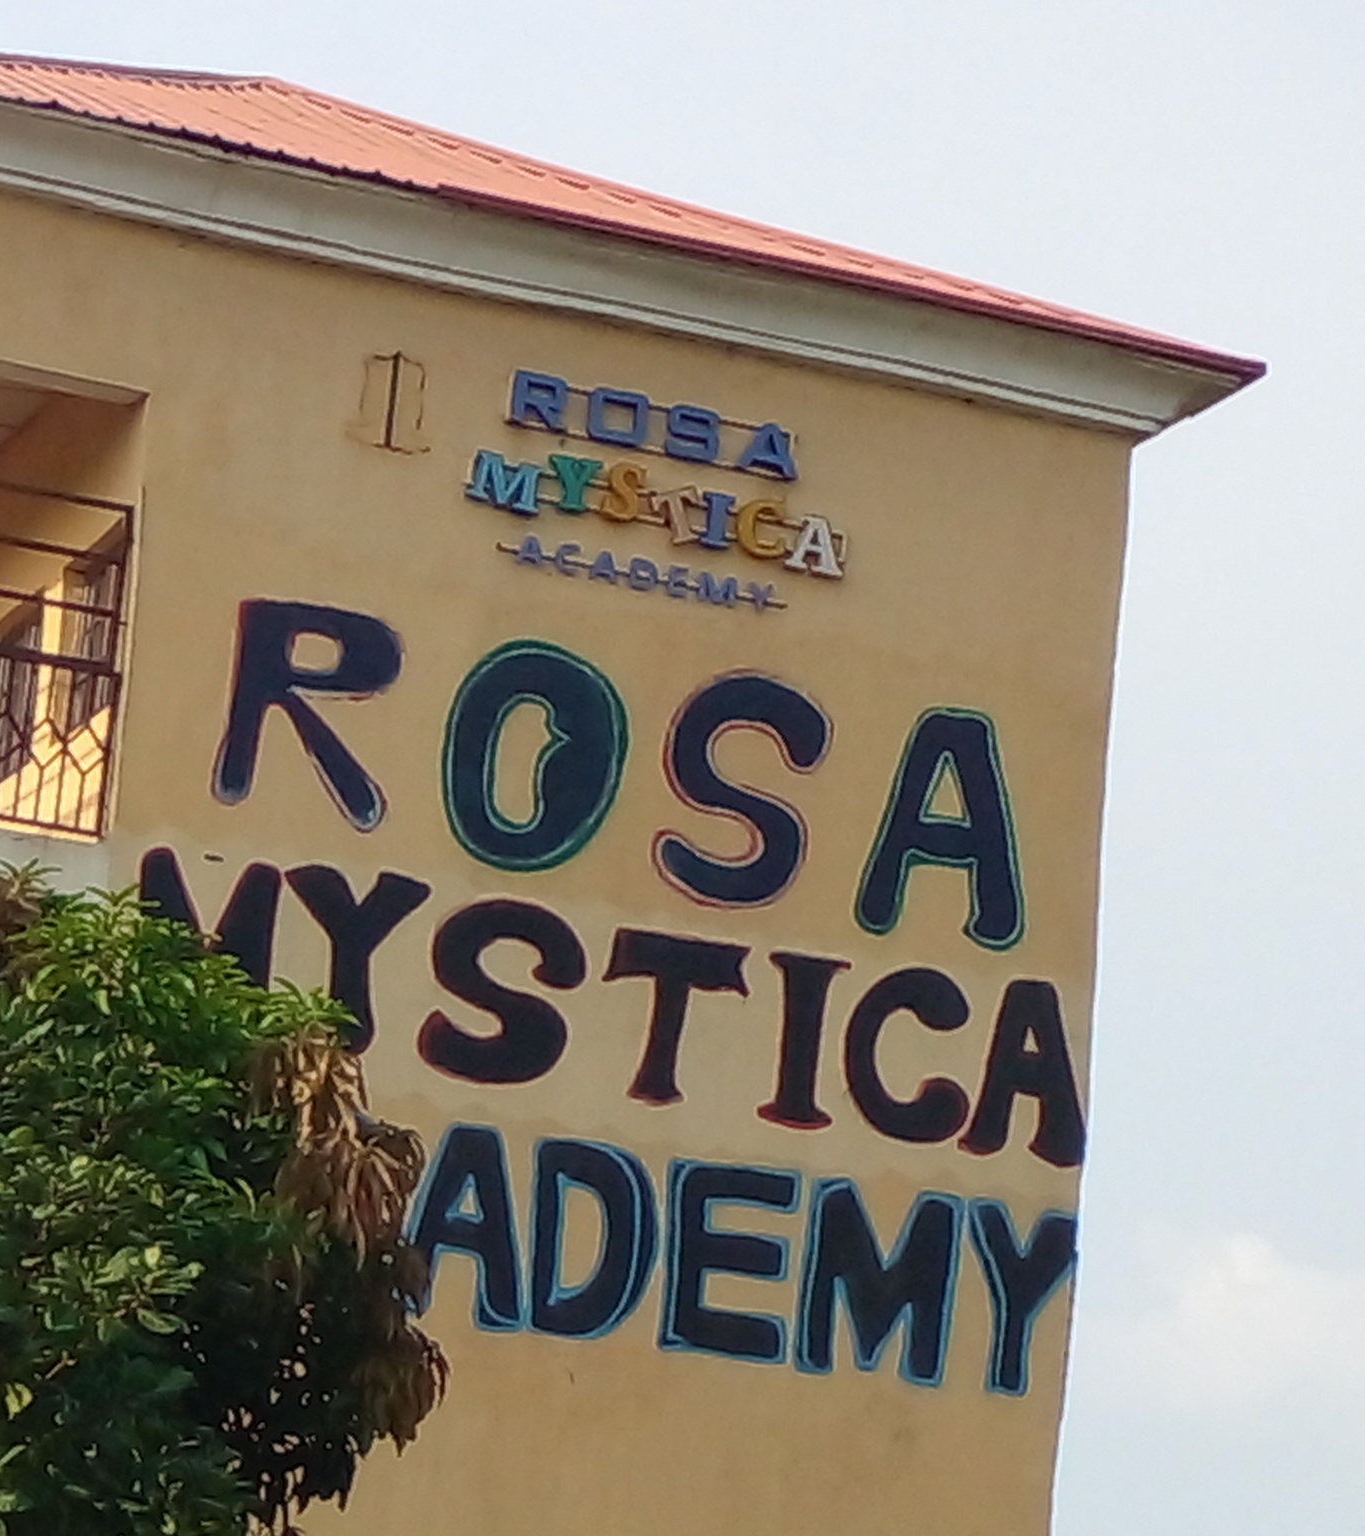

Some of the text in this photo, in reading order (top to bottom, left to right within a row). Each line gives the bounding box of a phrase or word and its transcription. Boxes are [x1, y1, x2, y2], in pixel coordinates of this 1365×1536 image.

[464, 448, 846, 580] MYSTICA
[505, 368, 800, 481] ROSA
[513, 533, 778, 614] ACADEMY
[211, 598, 1026, 951] ROSA
[137, 846, 1088, 1168] MYSTICA
[399, 1121, 1077, 1396] ADEMY
